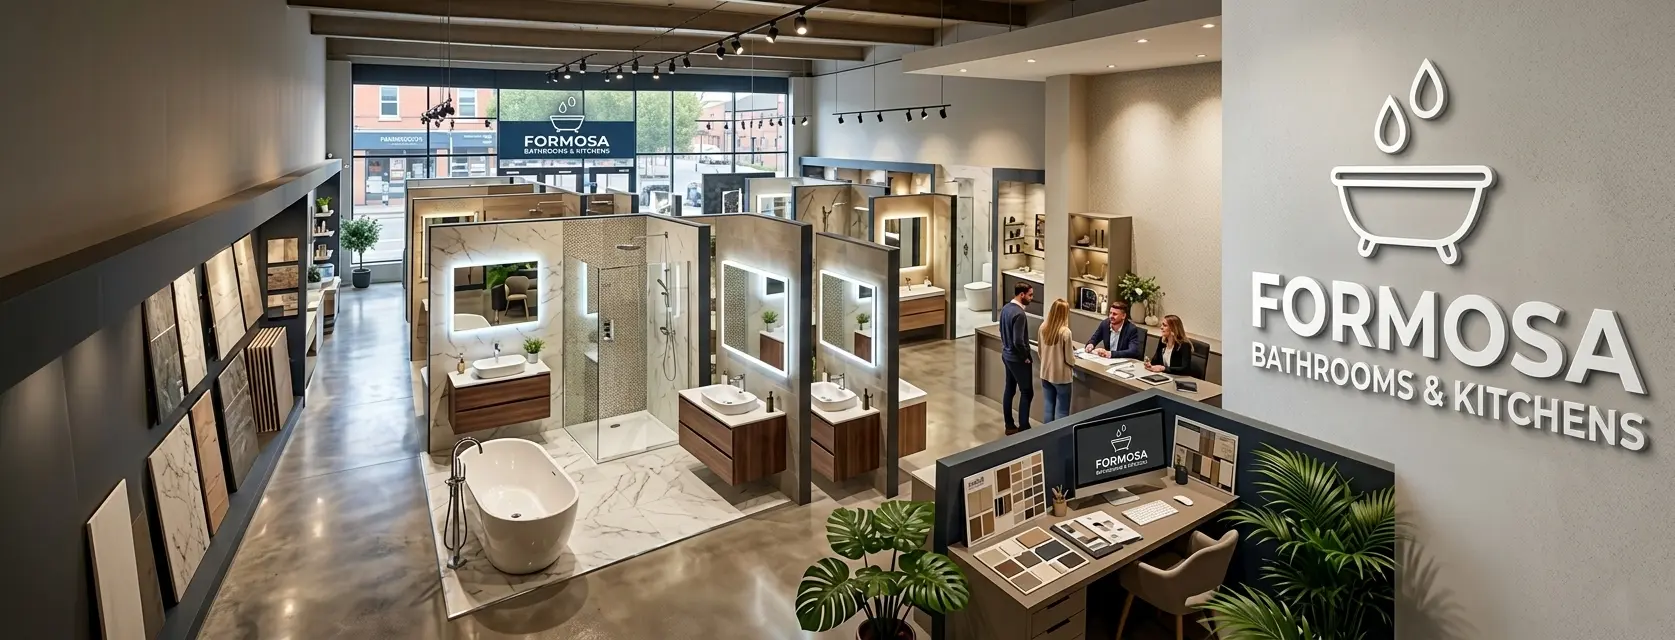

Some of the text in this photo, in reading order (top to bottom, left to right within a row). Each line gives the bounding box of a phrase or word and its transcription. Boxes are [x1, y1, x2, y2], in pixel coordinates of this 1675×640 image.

[524, 135, 610, 147] FORMOSA
[1251, 271, 1648, 395] FORMOSA
[1252, 341, 1648, 452] BATHROOMS & KITCHENS
[1095, 450, 1148, 469] FORMOSA
